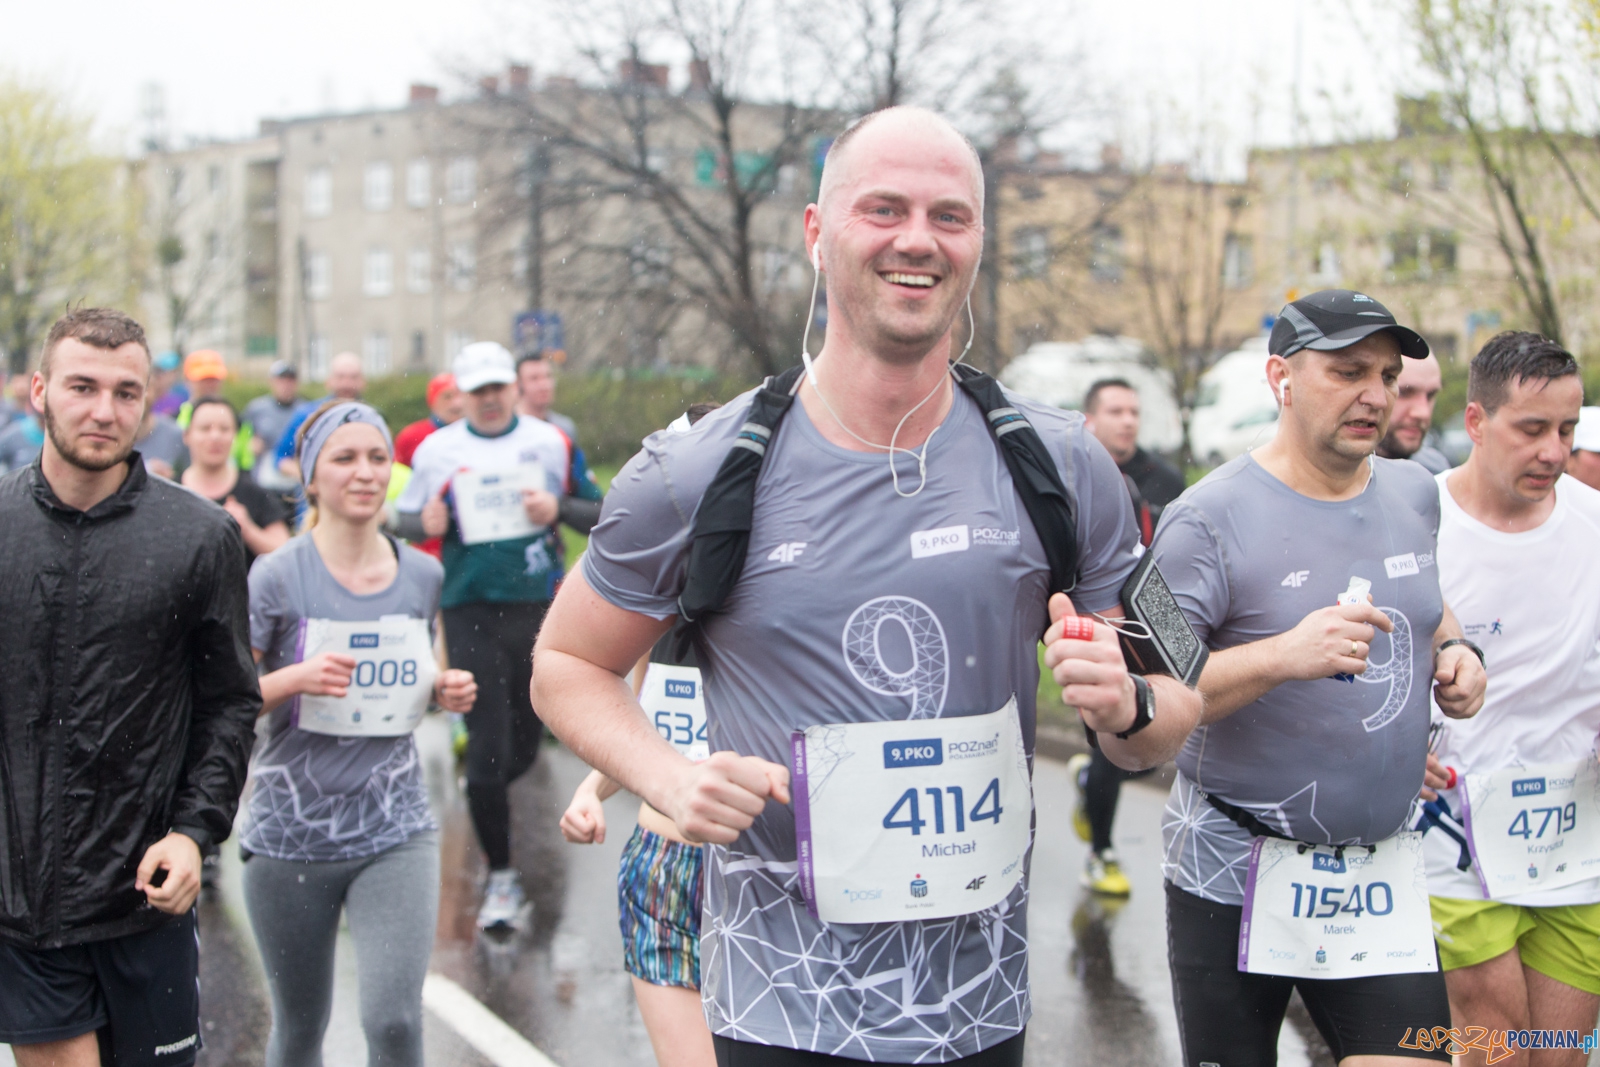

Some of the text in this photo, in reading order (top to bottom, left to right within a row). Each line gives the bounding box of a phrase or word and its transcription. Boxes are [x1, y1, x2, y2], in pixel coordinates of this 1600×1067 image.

[767, 542, 808, 563] 4F
[1281, 570, 1310, 588] 4F
[842, 595, 949, 721] 9
[350, 659, 417, 687] 008
[882, 777, 1004, 836] 4114
[1508, 801, 1577, 840] 4719
[921, 840, 976, 858] Michał
[965, 875, 987, 890] 4F
[1291, 882, 1393, 919] 11540
[1324, 924, 1356, 935] Marek
[1351, 952, 1368, 961] 4F
